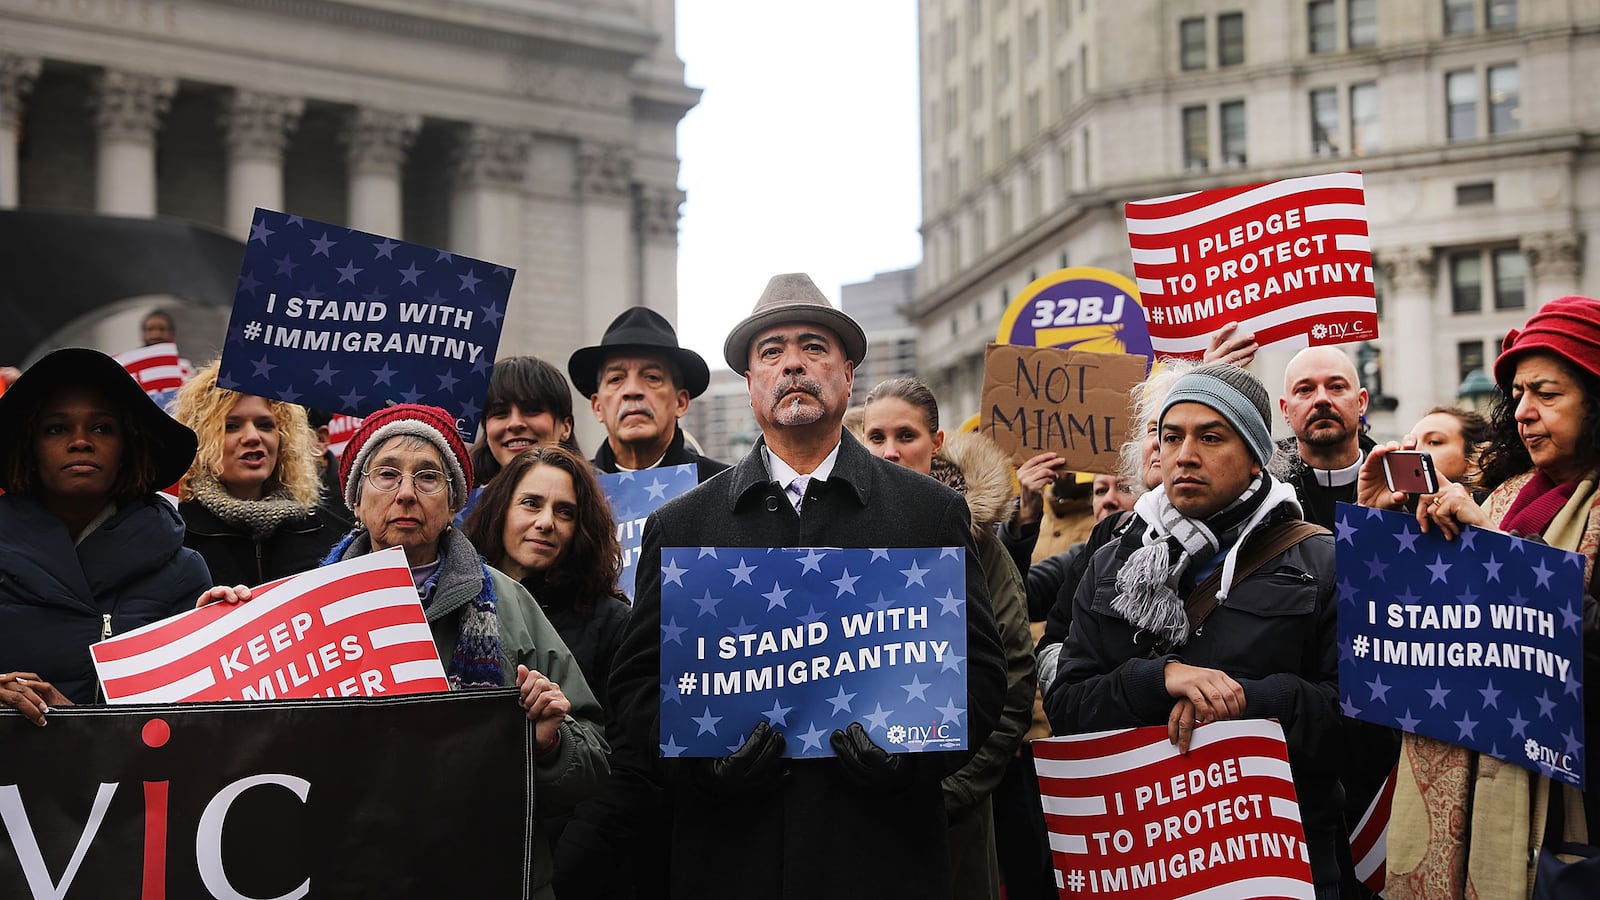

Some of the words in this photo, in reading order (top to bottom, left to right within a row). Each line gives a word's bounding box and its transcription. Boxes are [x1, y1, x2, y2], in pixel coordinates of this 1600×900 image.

[1182, 244, 1190, 263] I
[1199, 208, 1301, 258] PLEDGE
[1166, 274, 1196, 296] TO
[1205, 234, 1328, 287] PROTECT
[266, 293, 276, 313] I
[285, 297, 387, 321] STAND
[400, 302, 474, 330] WITH
[1031, 294, 1125, 328] 32BJ
[1151, 263, 1362, 325] #IMMIGRANTNY
[243, 321, 483, 364] #IMMIGRANTNY
[1016, 356, 1099, 404] NOT
[992, 404, 1118, 455] MIAMI
[219, 612, 312, 680] KEEP
[697, 637, 705, 659] I
[719, 621, 828, 659] STAND
[841, 606, 928, 638] WITH
[1368, 601, 1376, 625] I
[1387, 604, 1481, 629] STAND
[1490, 604, 1555, 639] WITH
[677, 641, 949, 696] #IMMIGRANTNY
[1352, 634, 1571, 683] #IMMIGRANTNY
[907, 720, 950, 745] nyic
[1540, 746, 1572, 771] nyic
[1114, 792, 1124, 815] I
[1135, 758, 1239, 811] PLEDGE
[1092, 829, 1134, 855] TO
[1144, 794, 1263, 847] PROTECT
[1067, 832, 1296, 893] #IMMIGRANTNY
